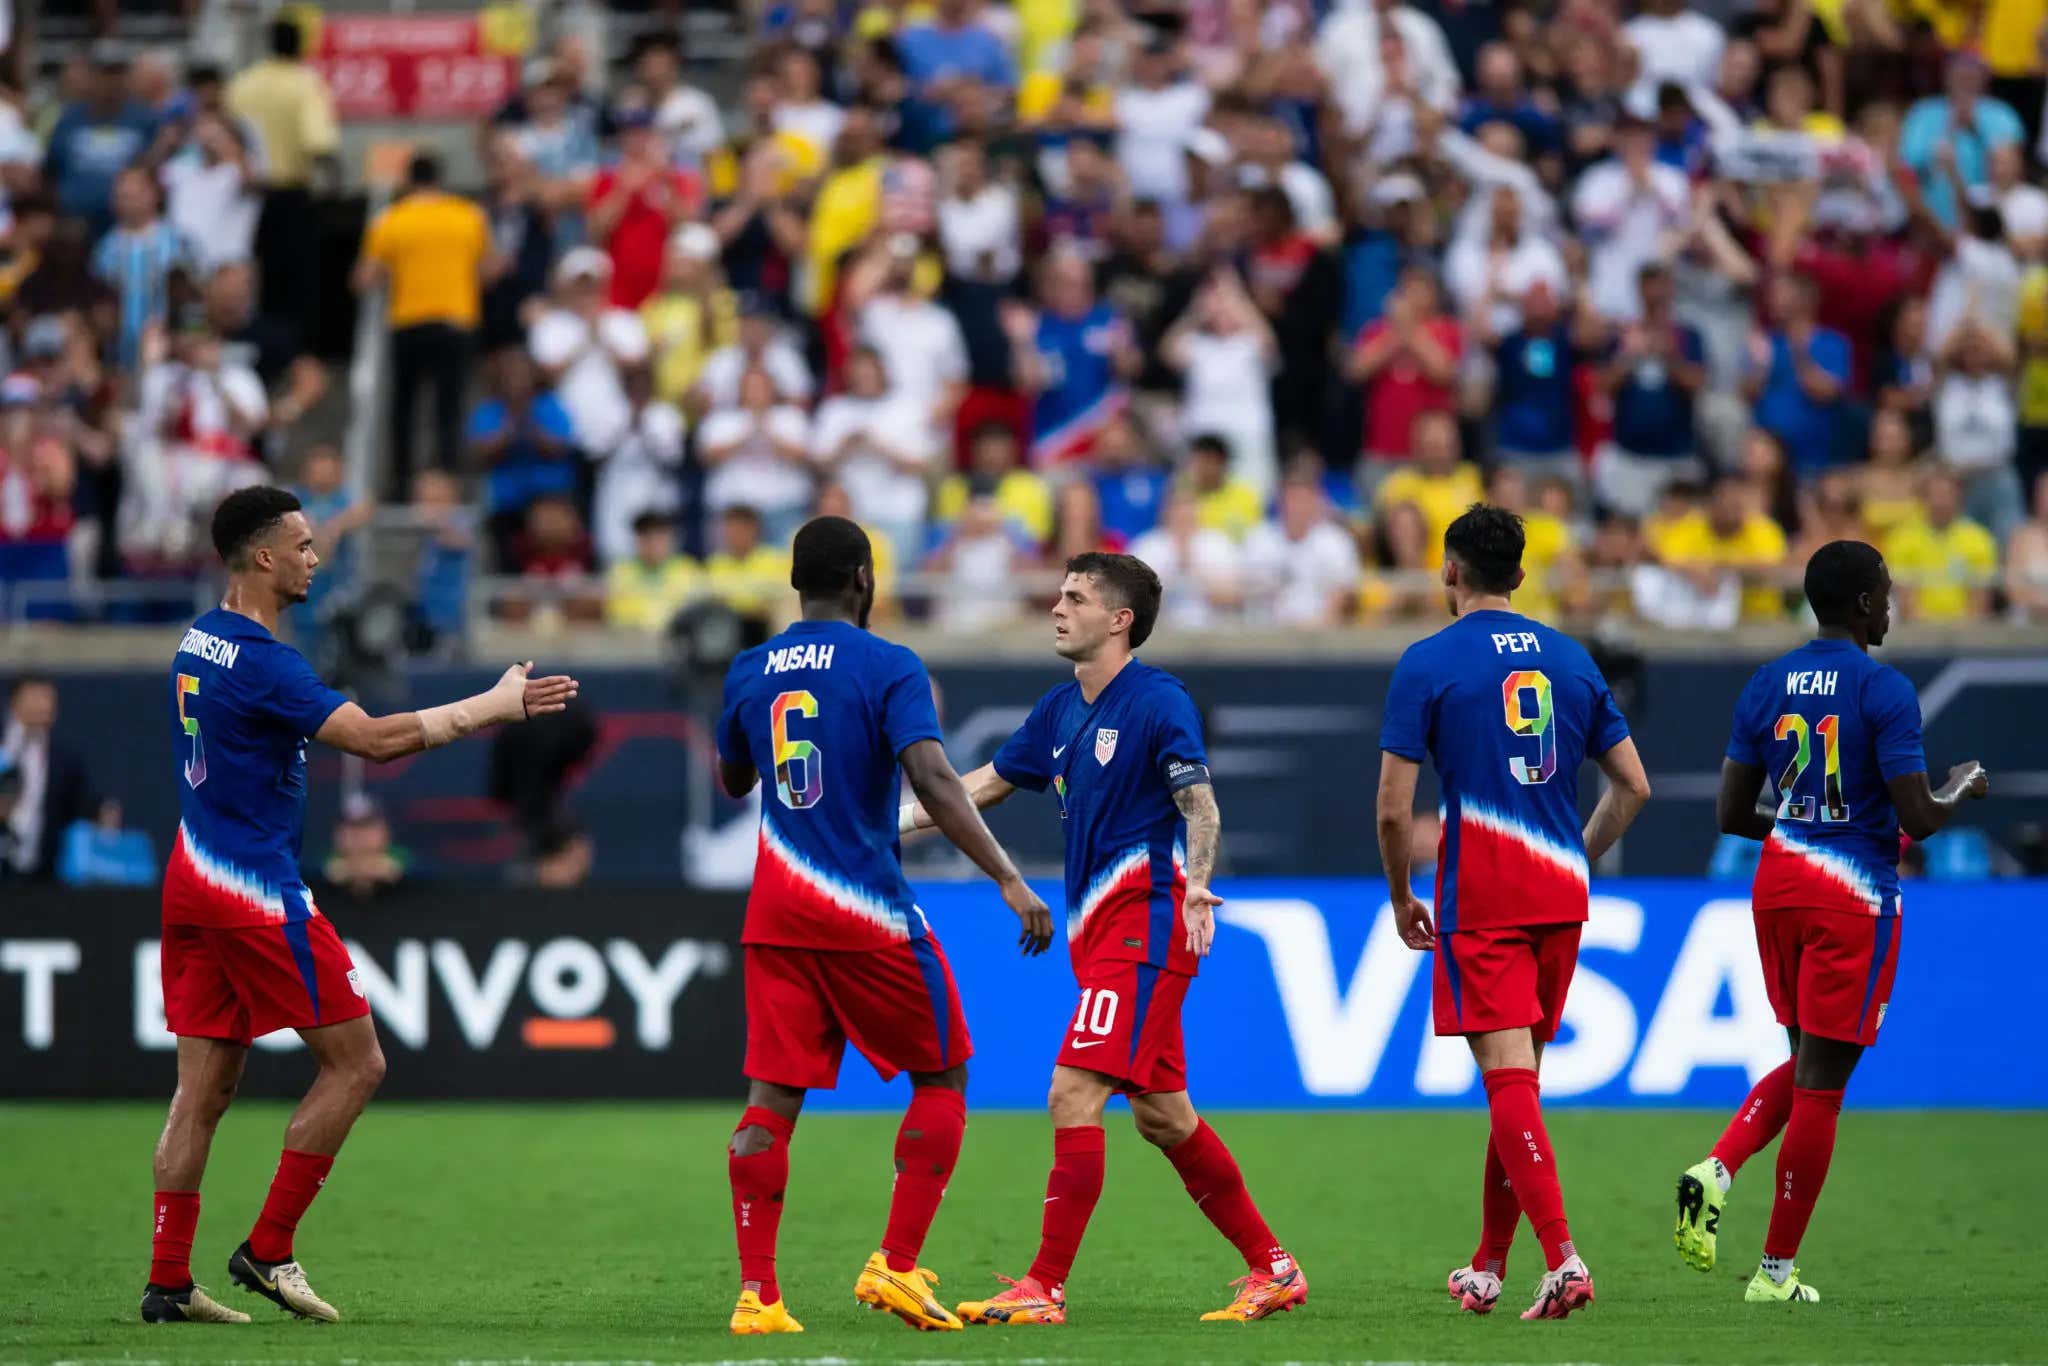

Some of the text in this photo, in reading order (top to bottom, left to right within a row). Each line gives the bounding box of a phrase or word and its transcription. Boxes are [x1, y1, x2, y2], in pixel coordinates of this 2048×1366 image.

[1491, 632, 1541, 654] PEPI
[764, 644, 835, 675] MUSAH
[1786, 670, 1838, 696] WEAH
[176, 672, 207, 790] 5
[1098, 730, 1117, 745] USA
[1502, 670, 1557, 785] 9
[770, 689, 823, 809] 6
[1169, 764, 1196, 779] BRAZIL
[1774, 713, 1849, 822] 21
[134, 936, 703, 1049] NVOY
[1073, 987, 1119, 1036] 10
[1743, 1098, 1763, 1123] USA
[1523, 1131, 1543, 1162] USA
[1783, 1171, 1793, 1200] USA
[156, 1205, 167, 1233] USA
[741, 1201, 751, 1227] USA
